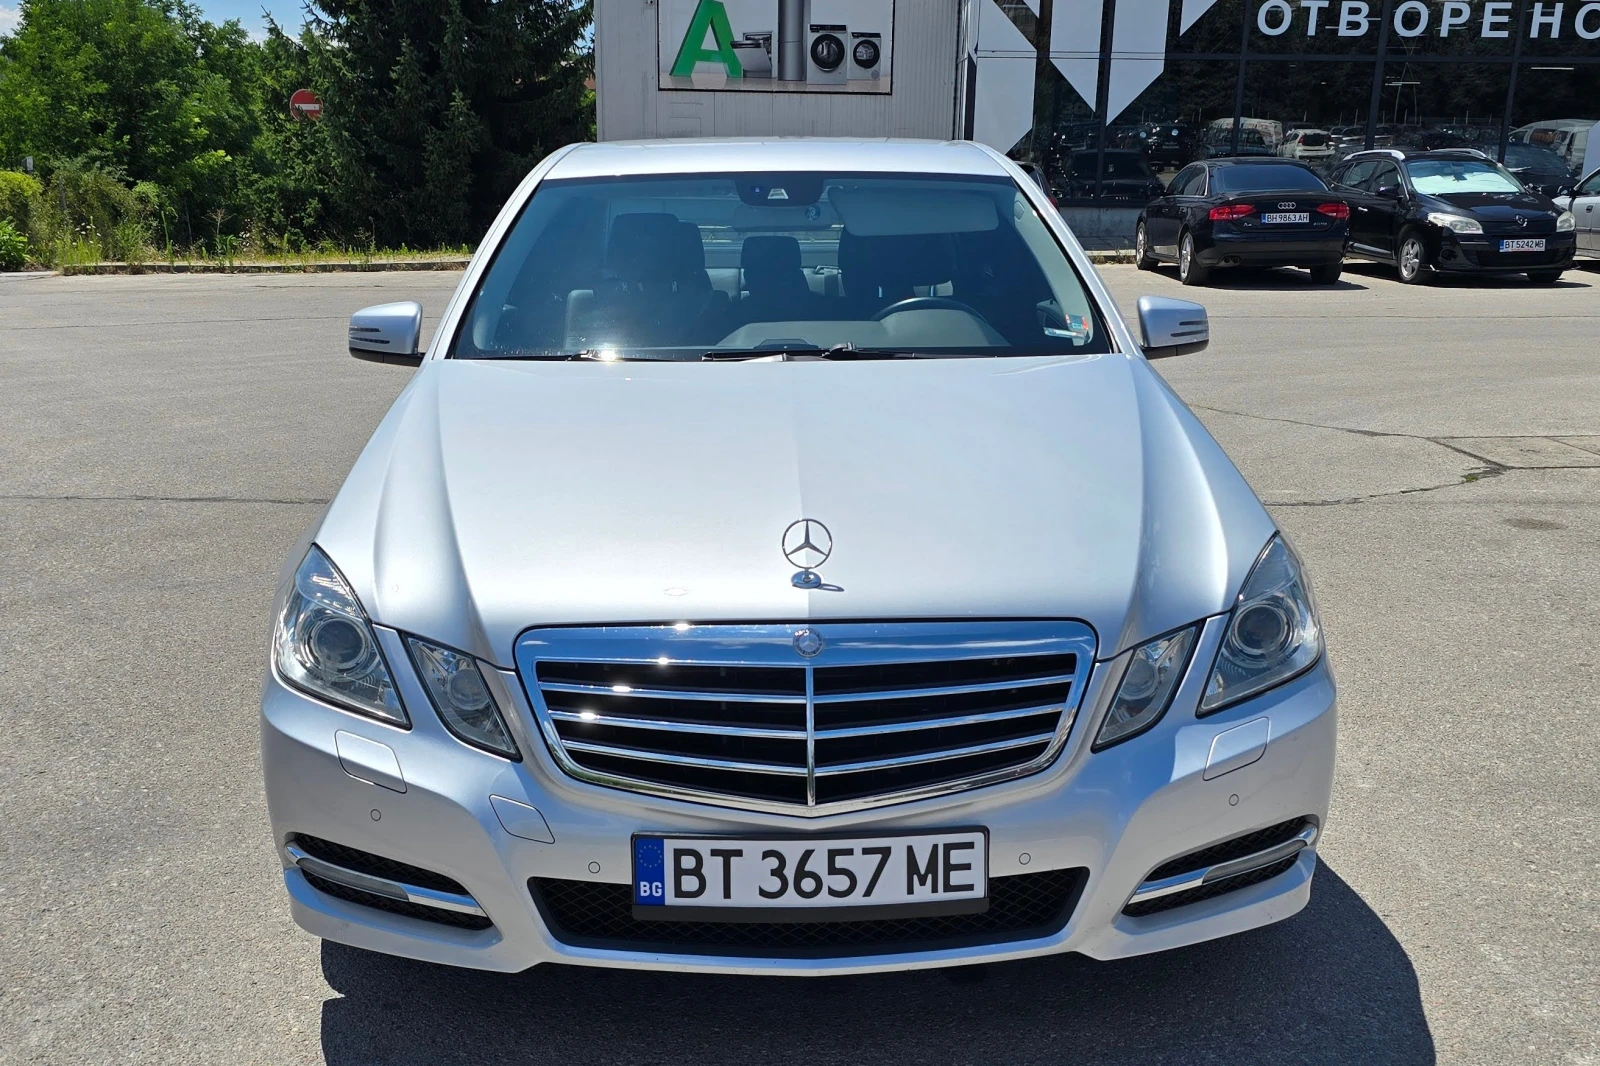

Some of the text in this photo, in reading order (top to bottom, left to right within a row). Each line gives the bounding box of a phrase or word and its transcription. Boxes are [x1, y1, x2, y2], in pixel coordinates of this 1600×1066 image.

[1278, 213, 1297, 222] 9863
[1298, 213, 1309, 222] AH
[1516, 240, 1534, 249] 5242
[673, 841, 975, 899] BT 3657 ME
[640, 881, 663, 897] BG
